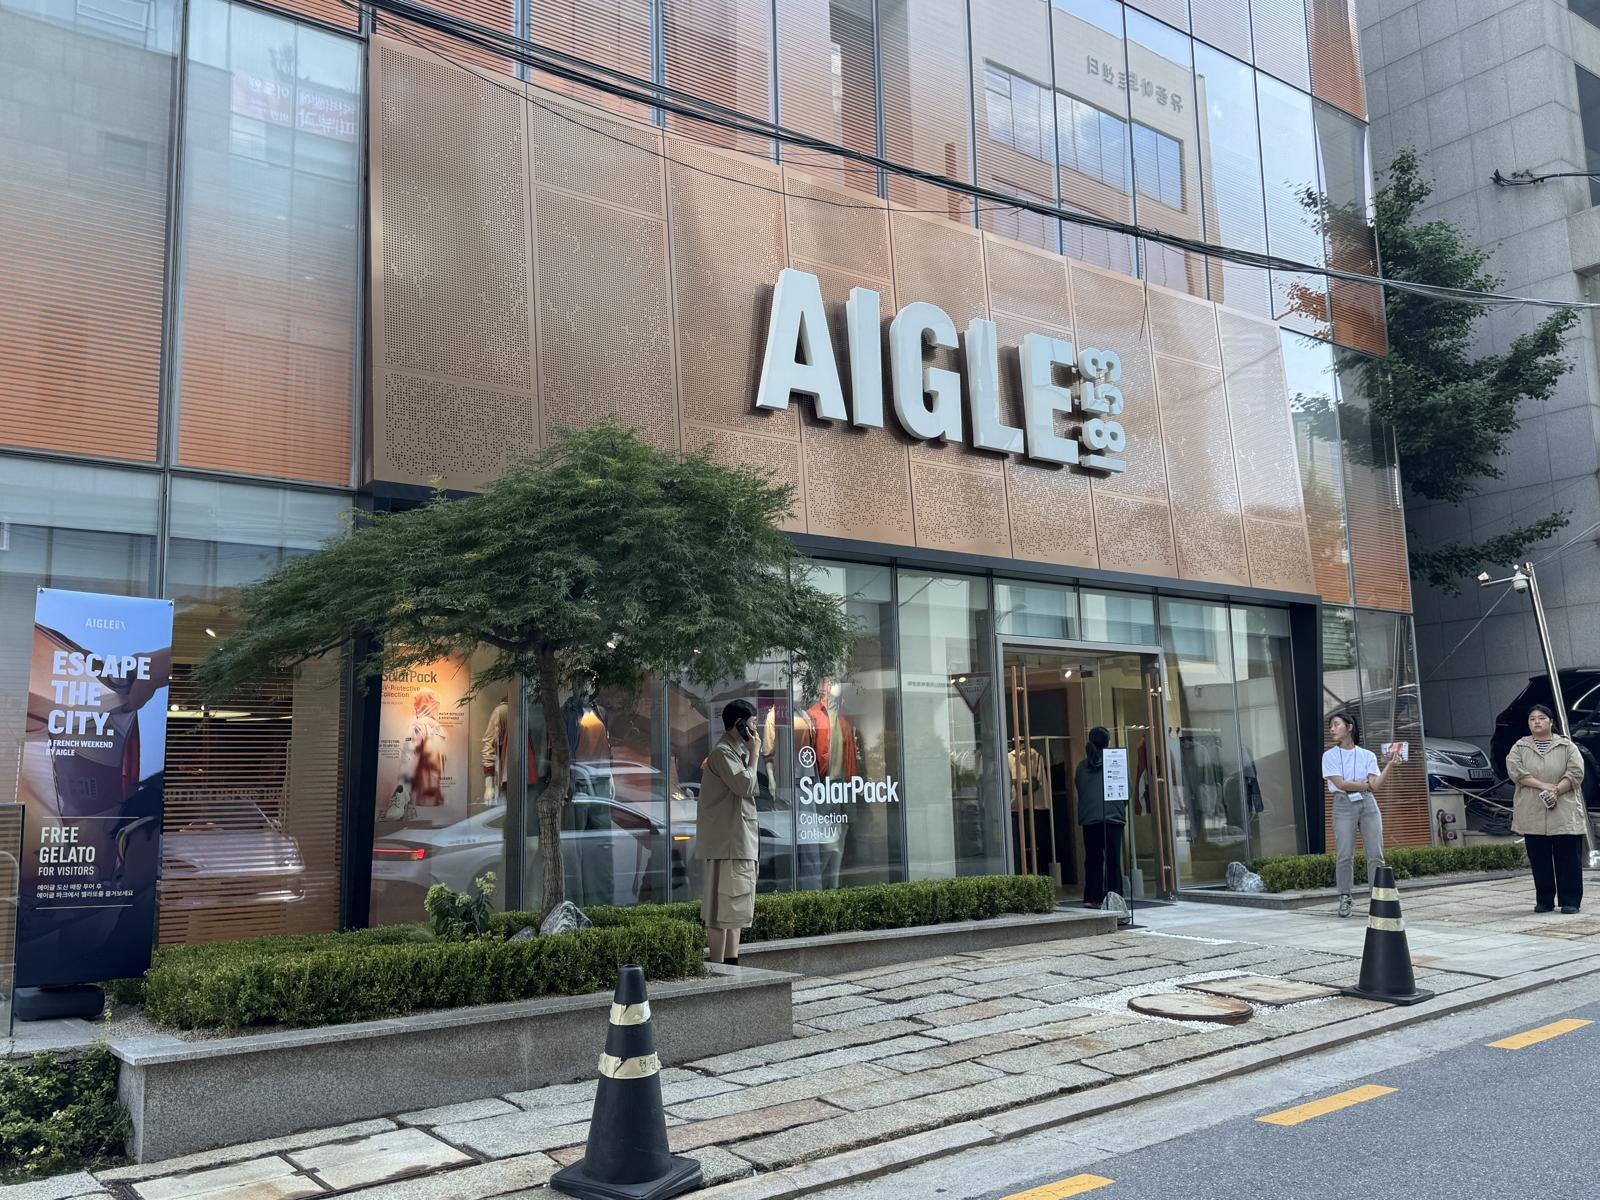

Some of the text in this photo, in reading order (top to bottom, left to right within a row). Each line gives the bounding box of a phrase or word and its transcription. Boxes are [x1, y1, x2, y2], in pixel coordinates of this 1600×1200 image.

[756, 267, 1079, 465] AIGLE
[1078, 346, 1127, 473] 1853
[52, 650, 152, 680] ESCAPE
[51, 680, 102, 706] THE
[48, 710, 114, 736] CITY.
[46, 748, 75, 756] BY AIGLE
[47, 739, 52, 747] A
[799, 775, 899, 805] SolarPack
[800, 812, 848, 825] Collection
[40, 826, 80, 843] FREE
[39, 846, 96, 864] GELATO
[38, 866, 95, 876] FOR VISITORS
